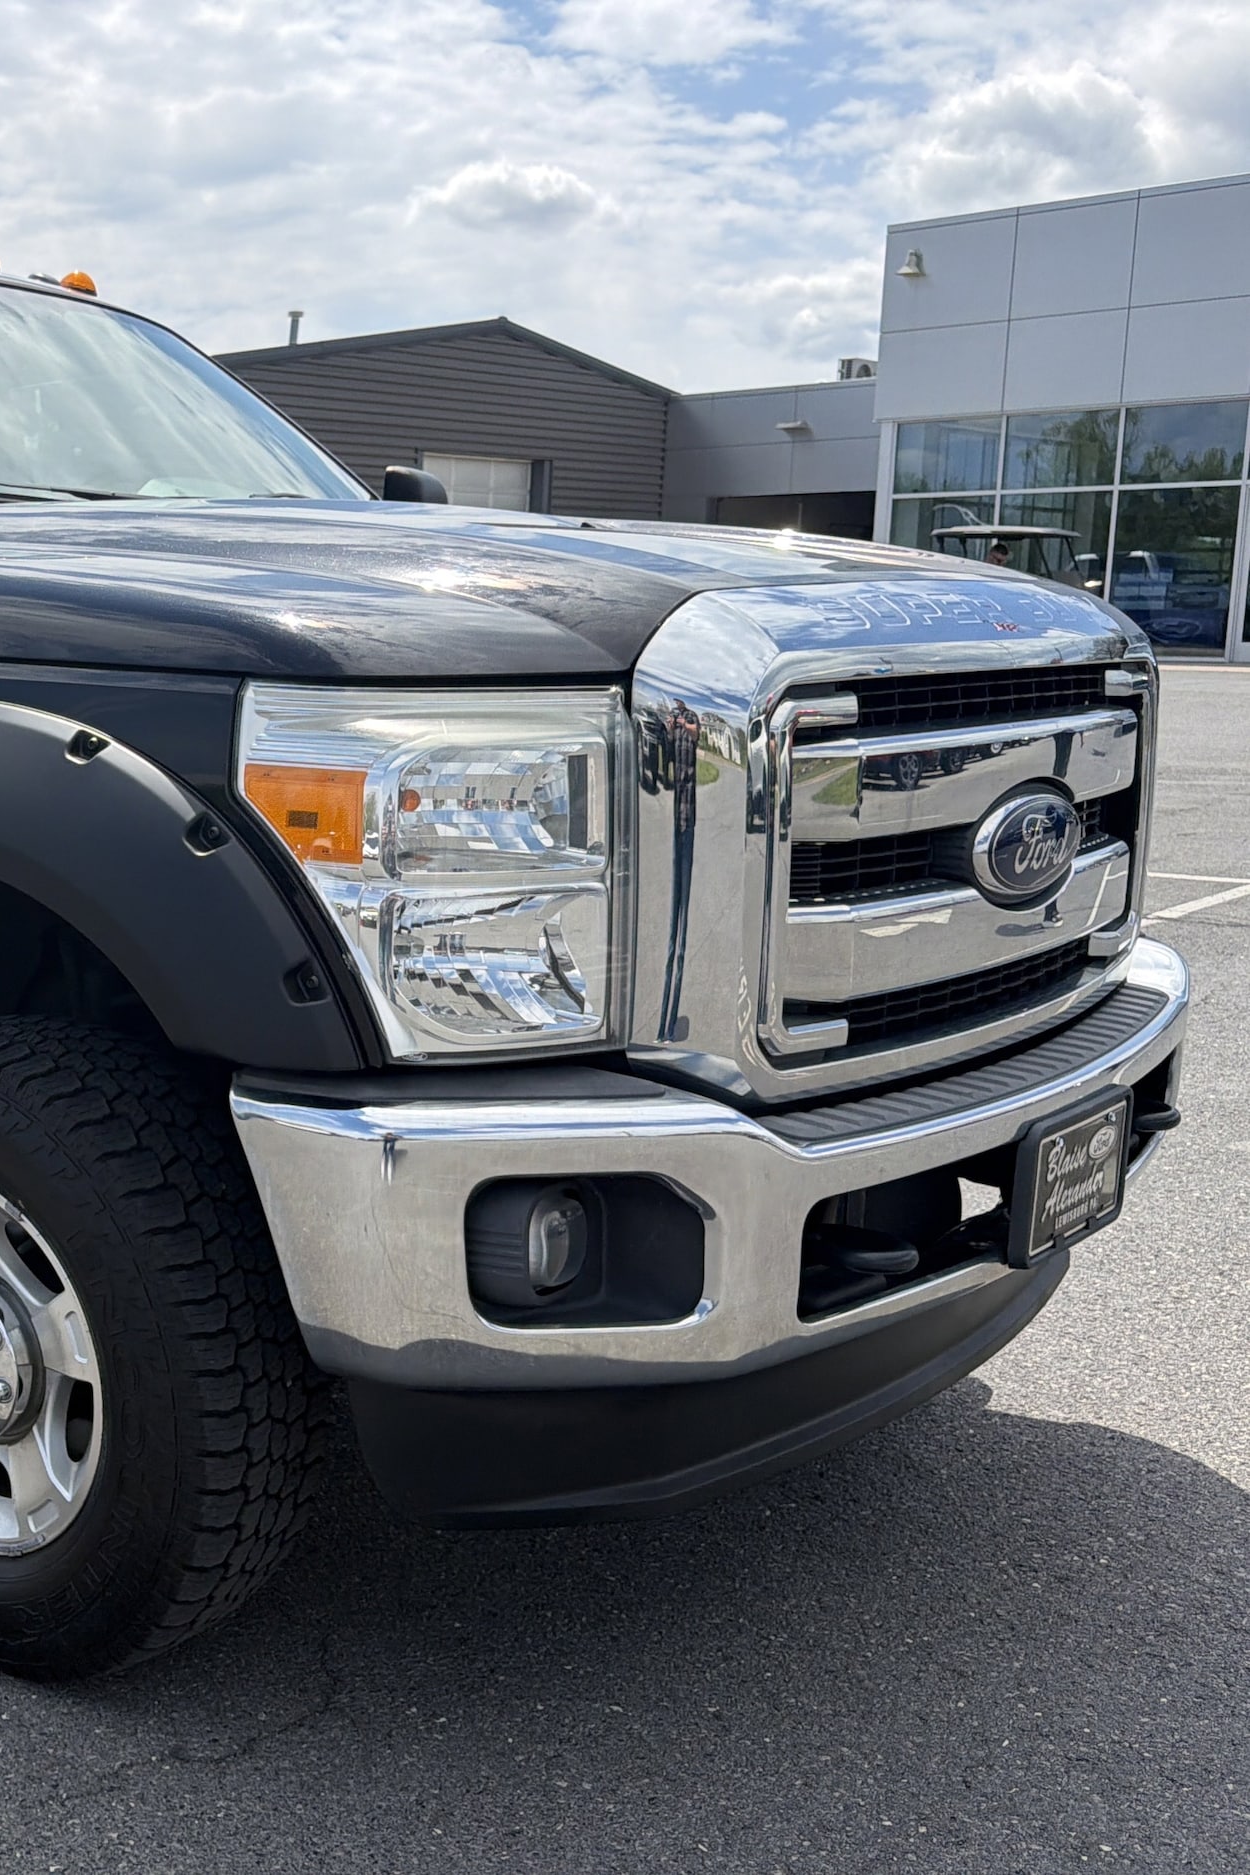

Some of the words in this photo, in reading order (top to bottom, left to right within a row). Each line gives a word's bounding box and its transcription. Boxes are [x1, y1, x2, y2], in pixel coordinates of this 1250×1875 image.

[818, 592, 1012, 630] SUPER
[1014, 813, 1072, 875] Ford
[1046, 1144, 1088, 1183] Blaise
[1041, 1166, 1105, 1225] Alexander
